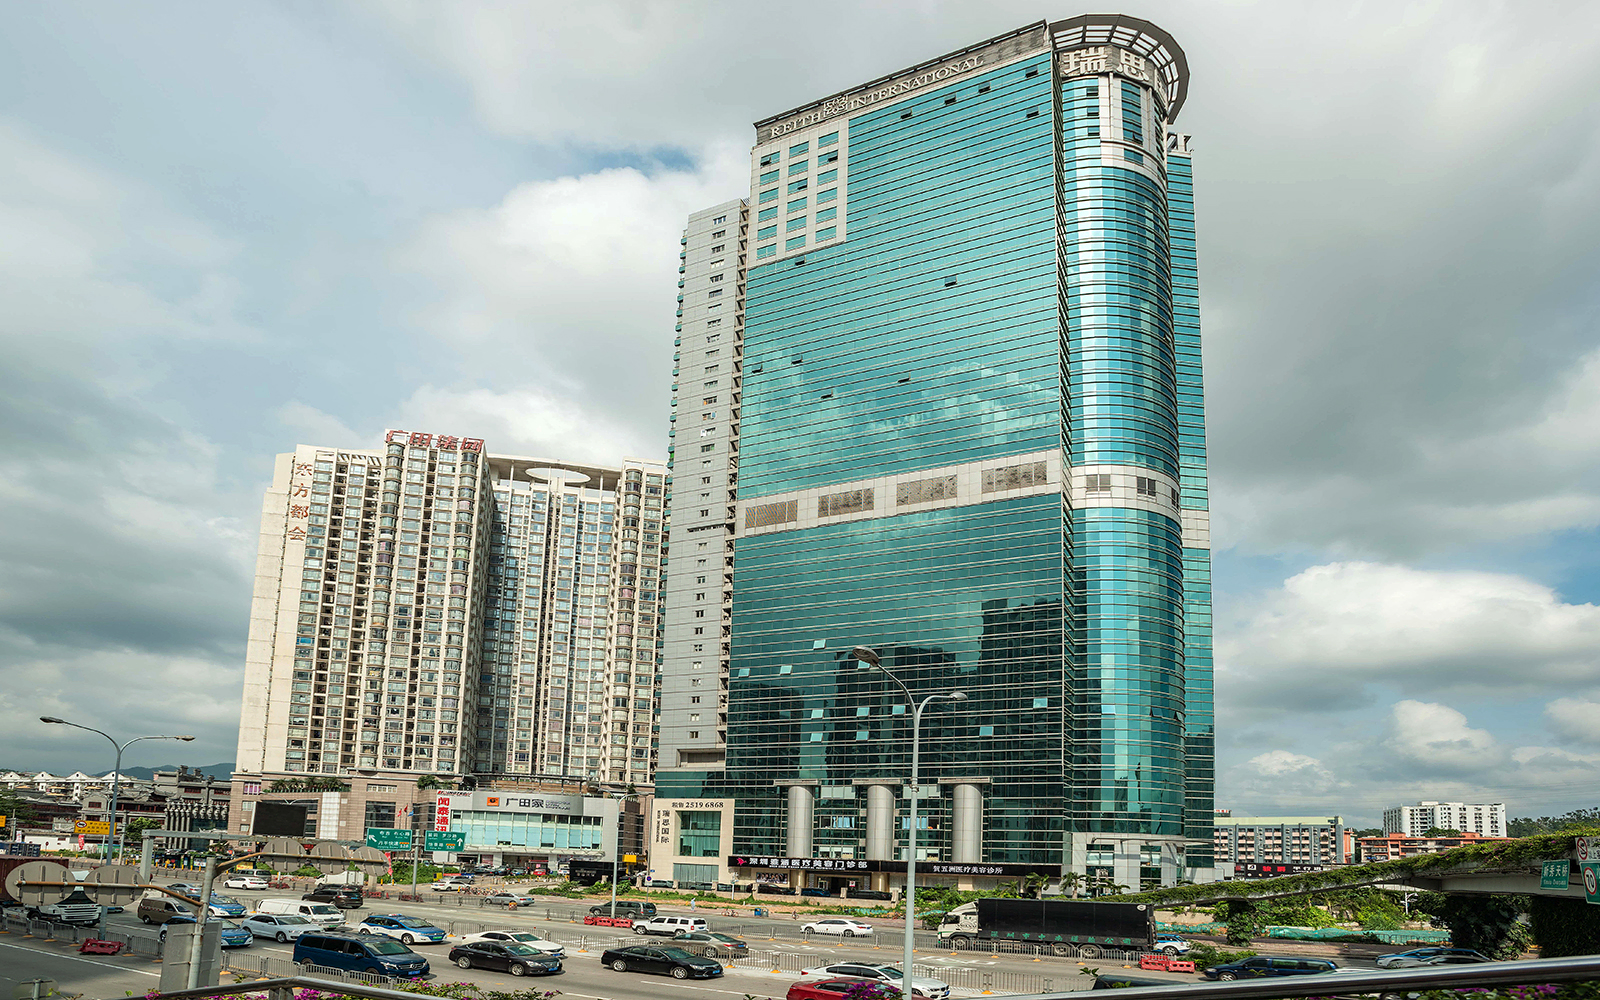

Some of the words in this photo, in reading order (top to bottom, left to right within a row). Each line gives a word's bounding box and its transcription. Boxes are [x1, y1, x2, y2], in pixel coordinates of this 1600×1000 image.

[1063, 46, 1150, 81] 瑞思
[771, 112, 821, 138] REITH
[850, 53, 984, 109] INTERNATIONAL
[386, 430, 485, 452] 广田集团
[288, 461, 314, 542] 东方都会
[506, 797, 544, 809] 广田家
[660, 809, 671, 844] 瑞思国际
[1585, 873, 1595, 889] 70
